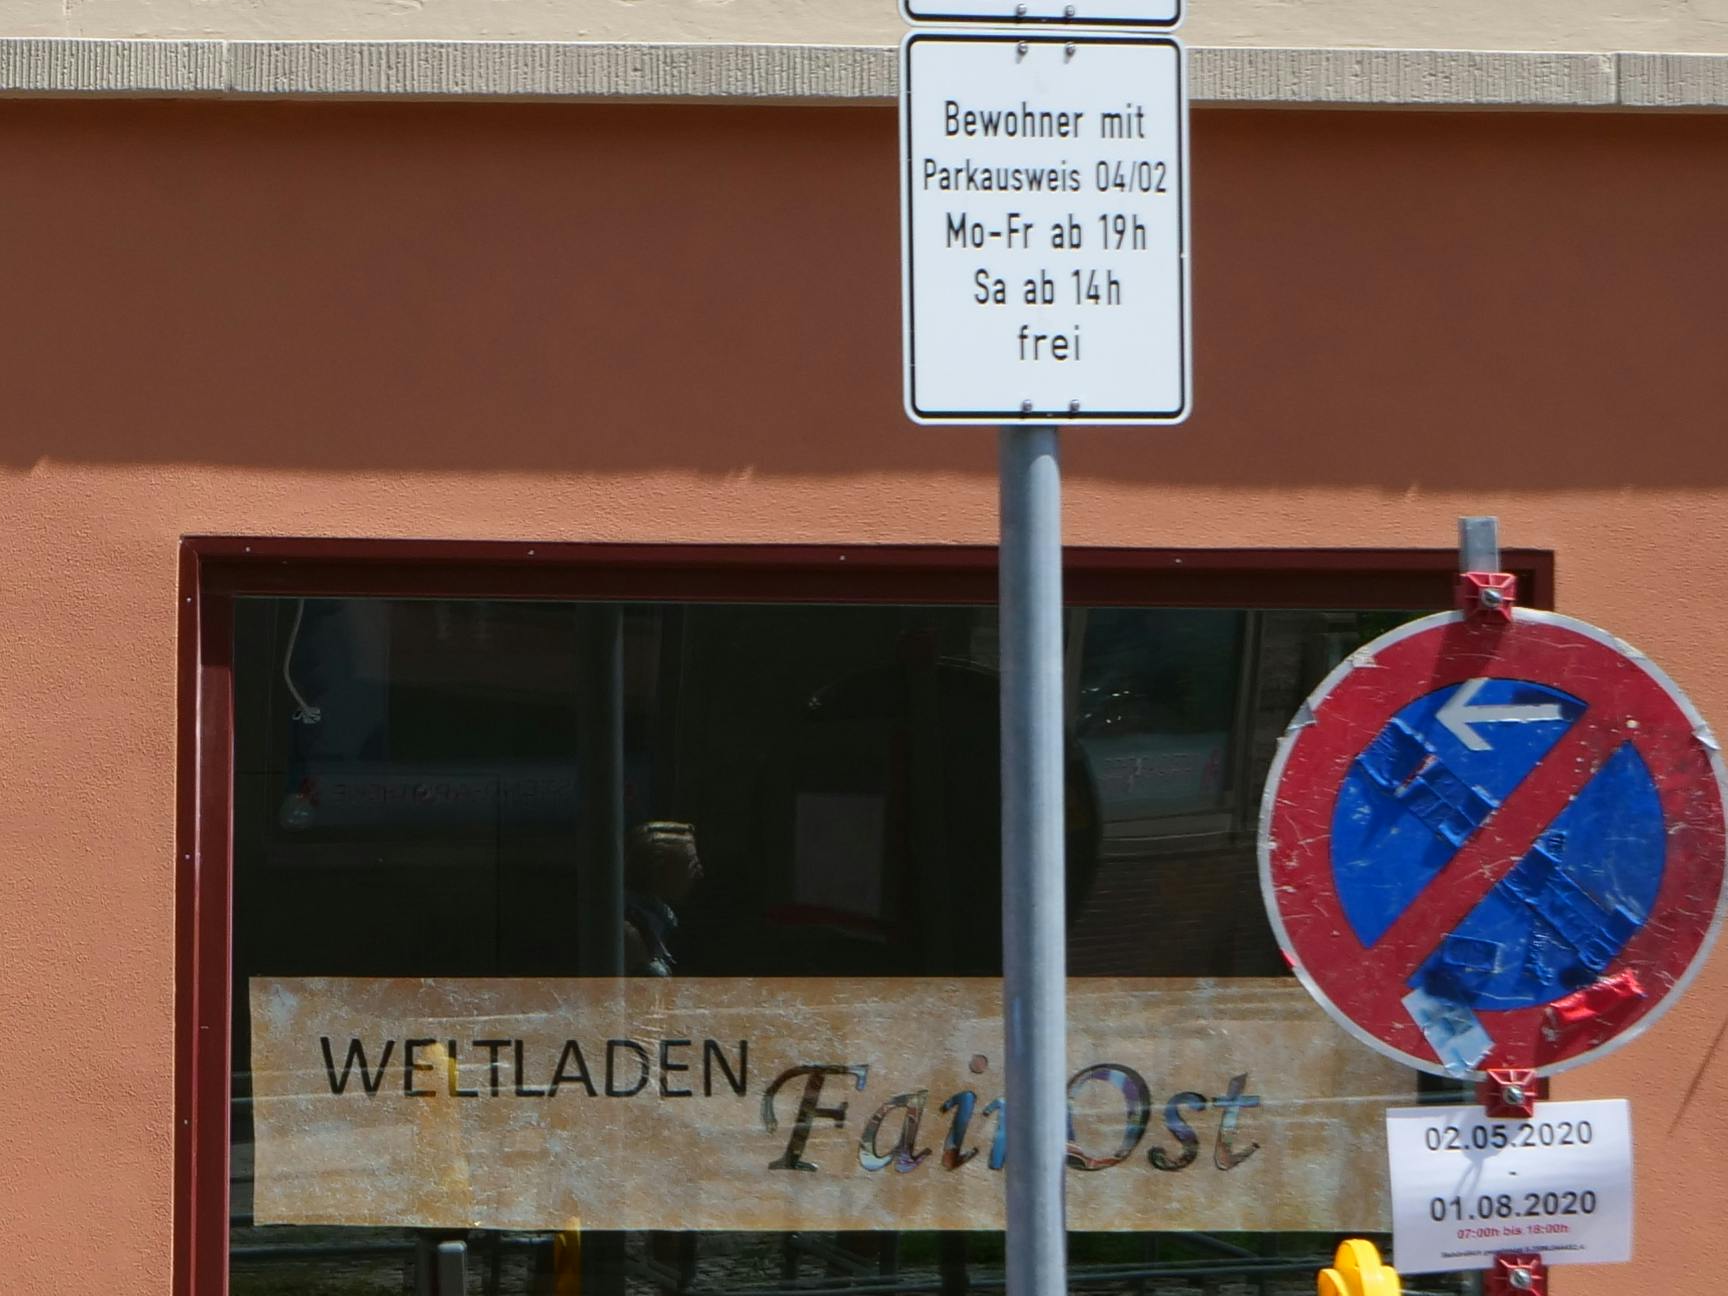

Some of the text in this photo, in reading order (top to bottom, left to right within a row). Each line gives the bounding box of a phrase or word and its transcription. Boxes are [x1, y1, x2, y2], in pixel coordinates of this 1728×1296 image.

[945, 99, 1146, 140] Bewohner mit
[923, 157, 1168, 194] Parkausweis 04/02
[946, 212, 1147, 251] Mo-Fr ab 19h
[974, 268, 1122, 306] Sa ab 14h
[1017, 324, 1081, 362] frei
[320, 1036, 749, 1098] WELTLADEN
[1425, 1120, 1594, 1151] 02.05.2020
[1429, 1190, 1597, 1222] 01.08.2020
[1502, 1225, 1522, 1237] bis
